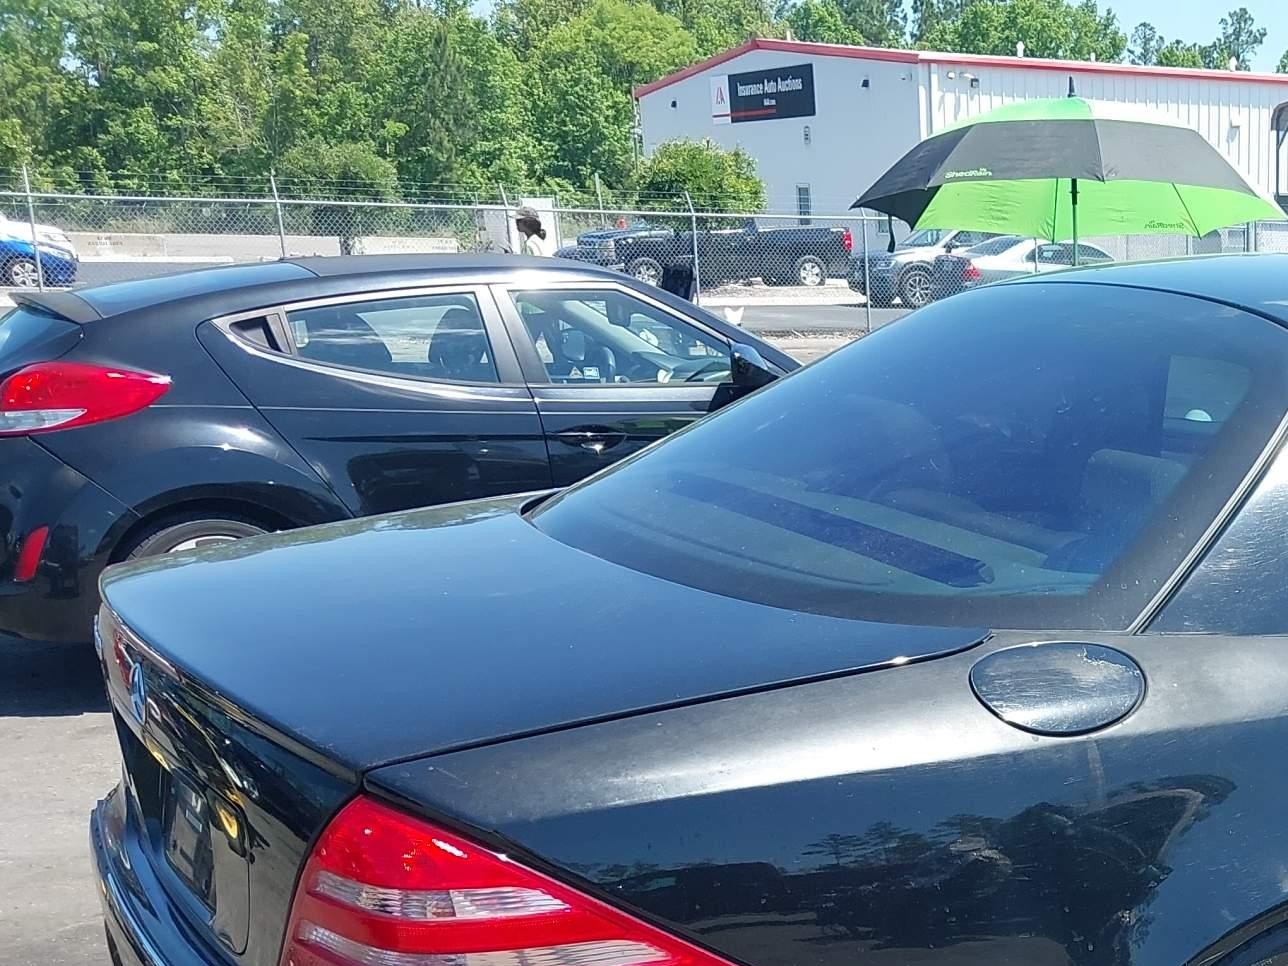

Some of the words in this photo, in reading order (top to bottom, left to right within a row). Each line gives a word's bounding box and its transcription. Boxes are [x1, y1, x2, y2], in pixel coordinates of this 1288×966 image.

[737, 82, 763, 96] Insurance
[764, 78, 777, 94] Auto
[777, 76, 802, 92] Auctions
